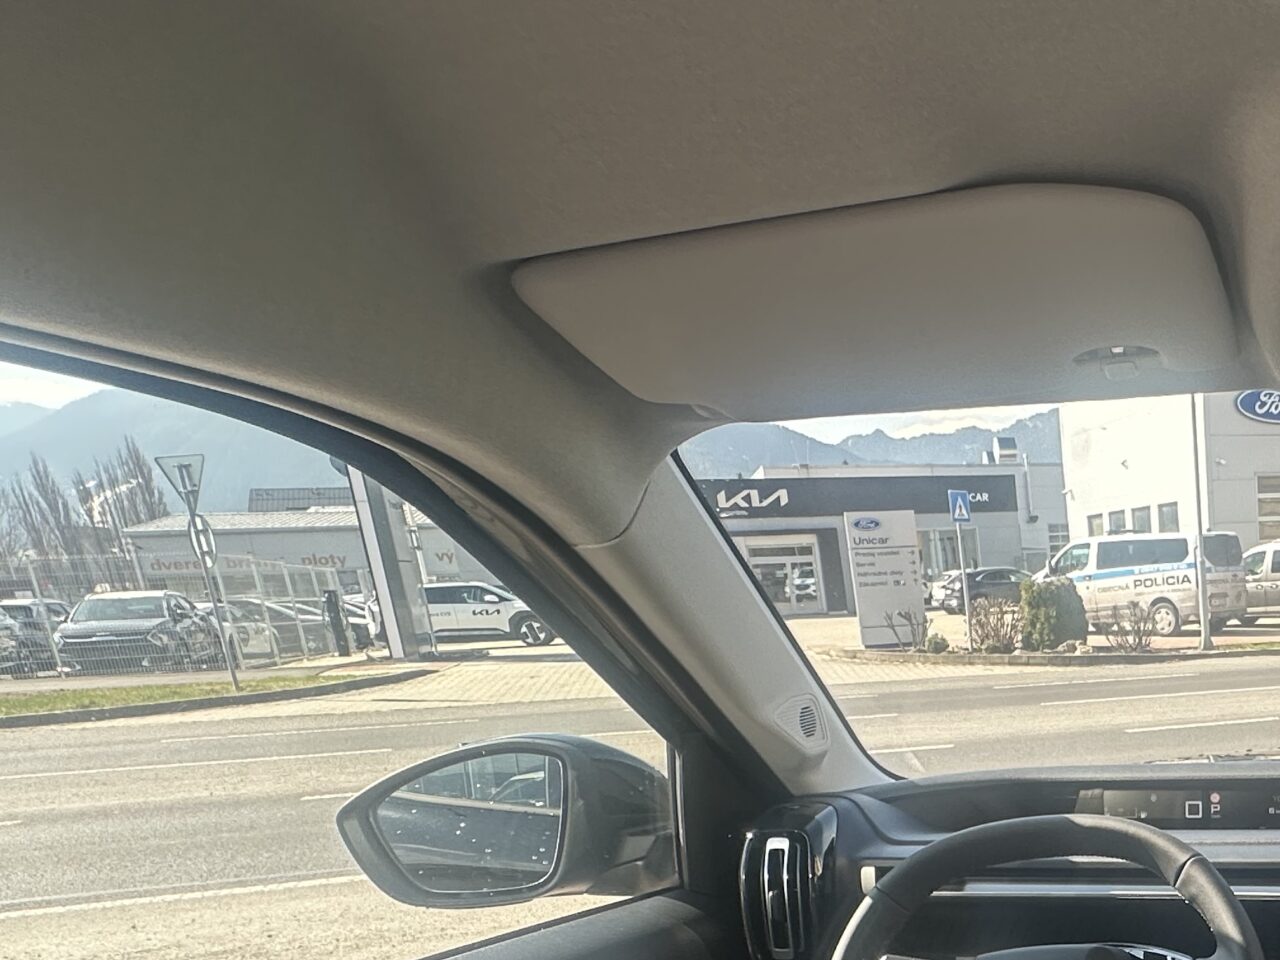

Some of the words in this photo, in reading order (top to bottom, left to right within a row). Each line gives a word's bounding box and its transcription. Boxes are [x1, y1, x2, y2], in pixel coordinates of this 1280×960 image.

[716, 488, 789, 508] KIA
[853, 536, 889, 546] Unicar
[1133, 574, 1192, 590] POLÍCIA
[471, 608, 501, 616] KIA
[1210, 804, 1221, 815] P
